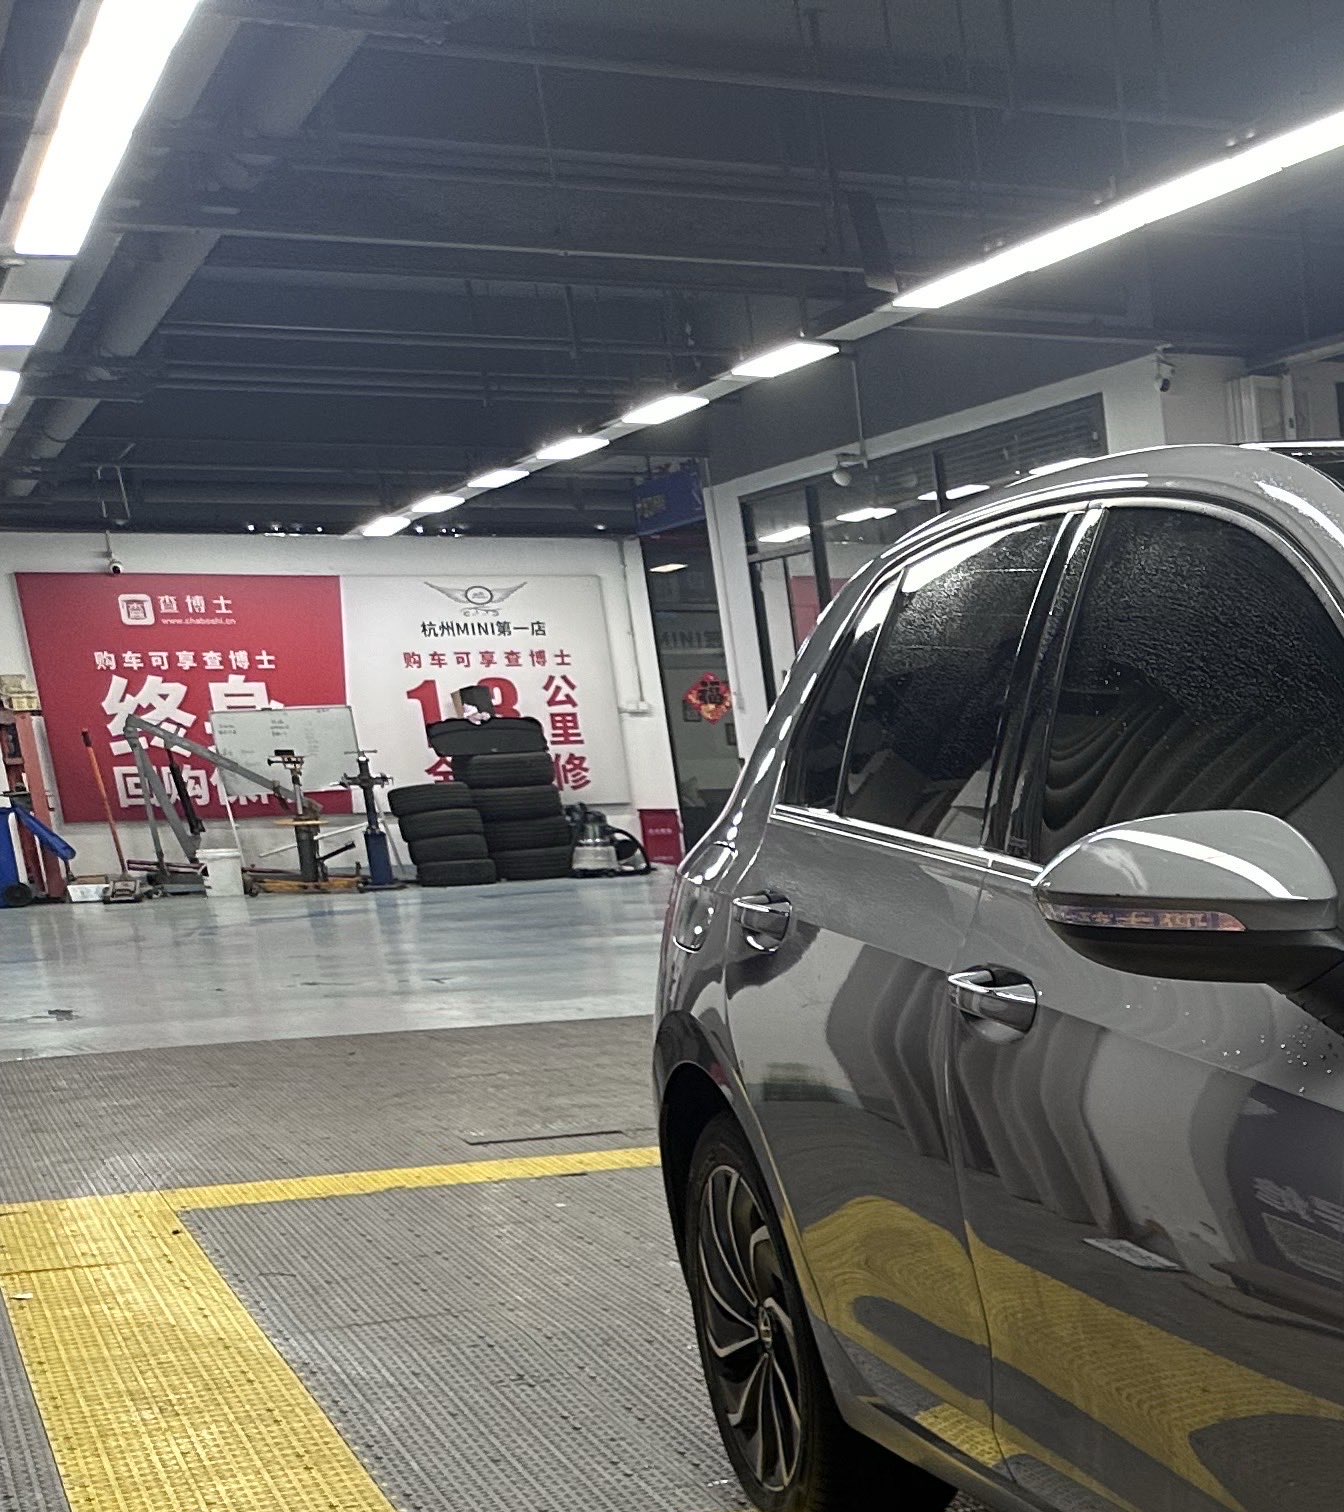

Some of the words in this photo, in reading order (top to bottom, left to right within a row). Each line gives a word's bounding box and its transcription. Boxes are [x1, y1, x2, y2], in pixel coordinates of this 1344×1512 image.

[158, 595, 232, 613] 查博士
[421, 620, 547, 638] 杭州MINI第一店
[94, 650, 276, 670] 购车可享查博士
[403, 649, 572, 669] 购车可享查博士
